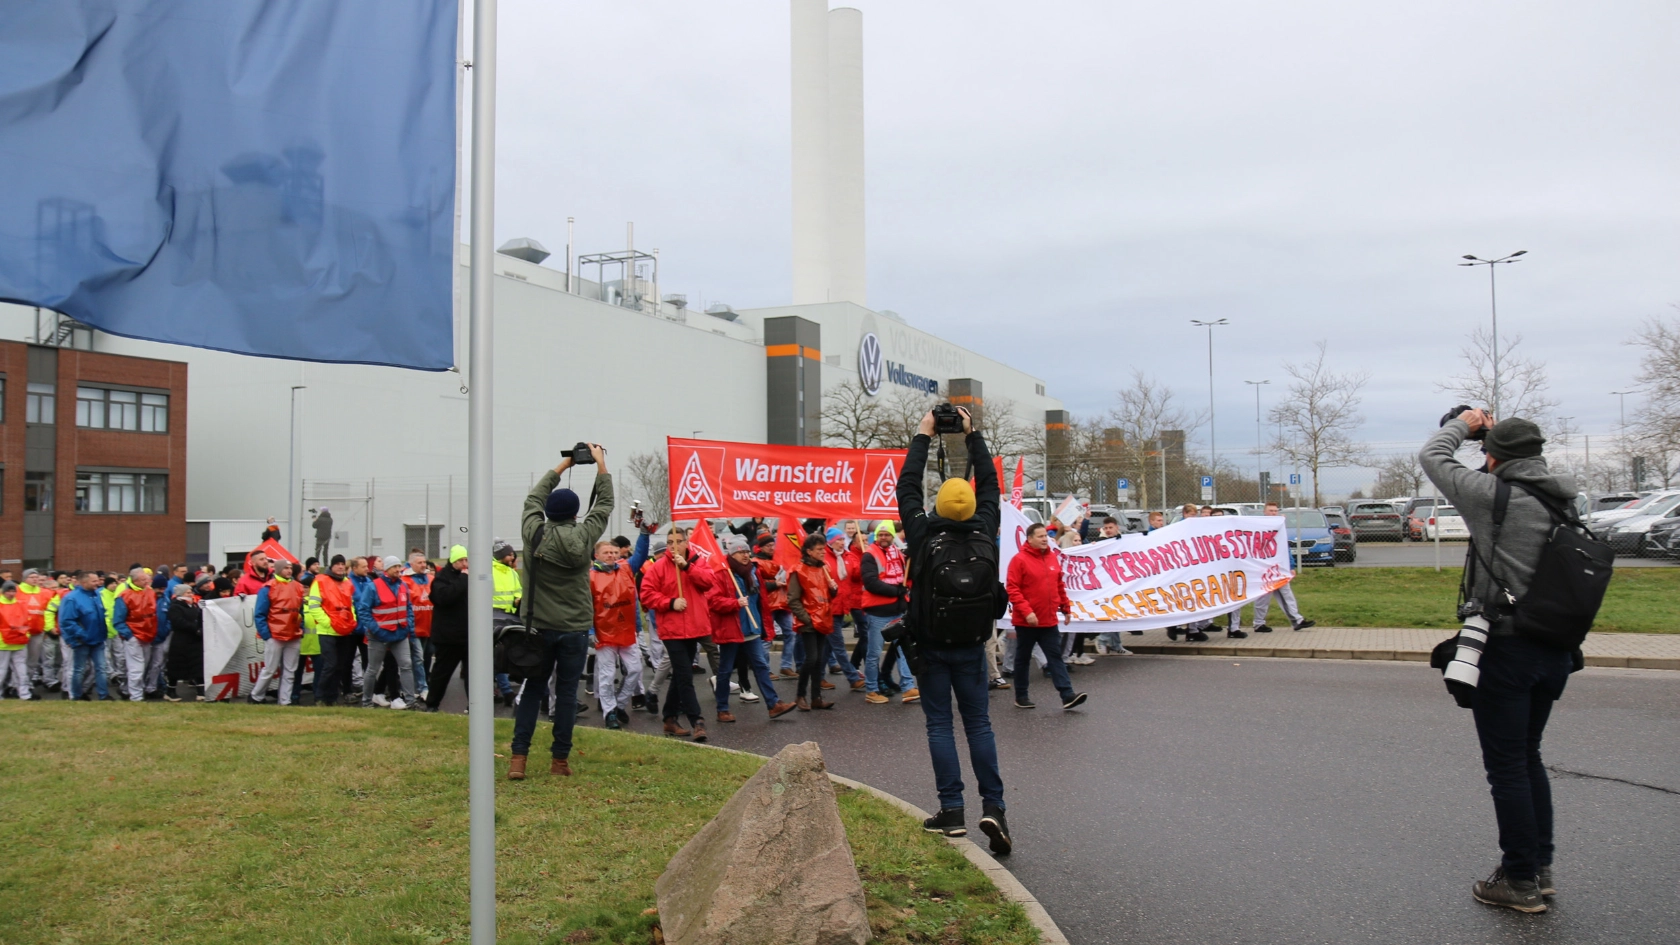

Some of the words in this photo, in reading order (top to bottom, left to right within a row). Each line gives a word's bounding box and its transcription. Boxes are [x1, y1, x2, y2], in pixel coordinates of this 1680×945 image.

[886, 359, 939, 396] Volkswagen
[735, 457, 855, 484] Warnstreik
[733, 489, 770, 502] unser
[774, 490, 811, 506] gutes
[815, 488, 852, 503] Recht
